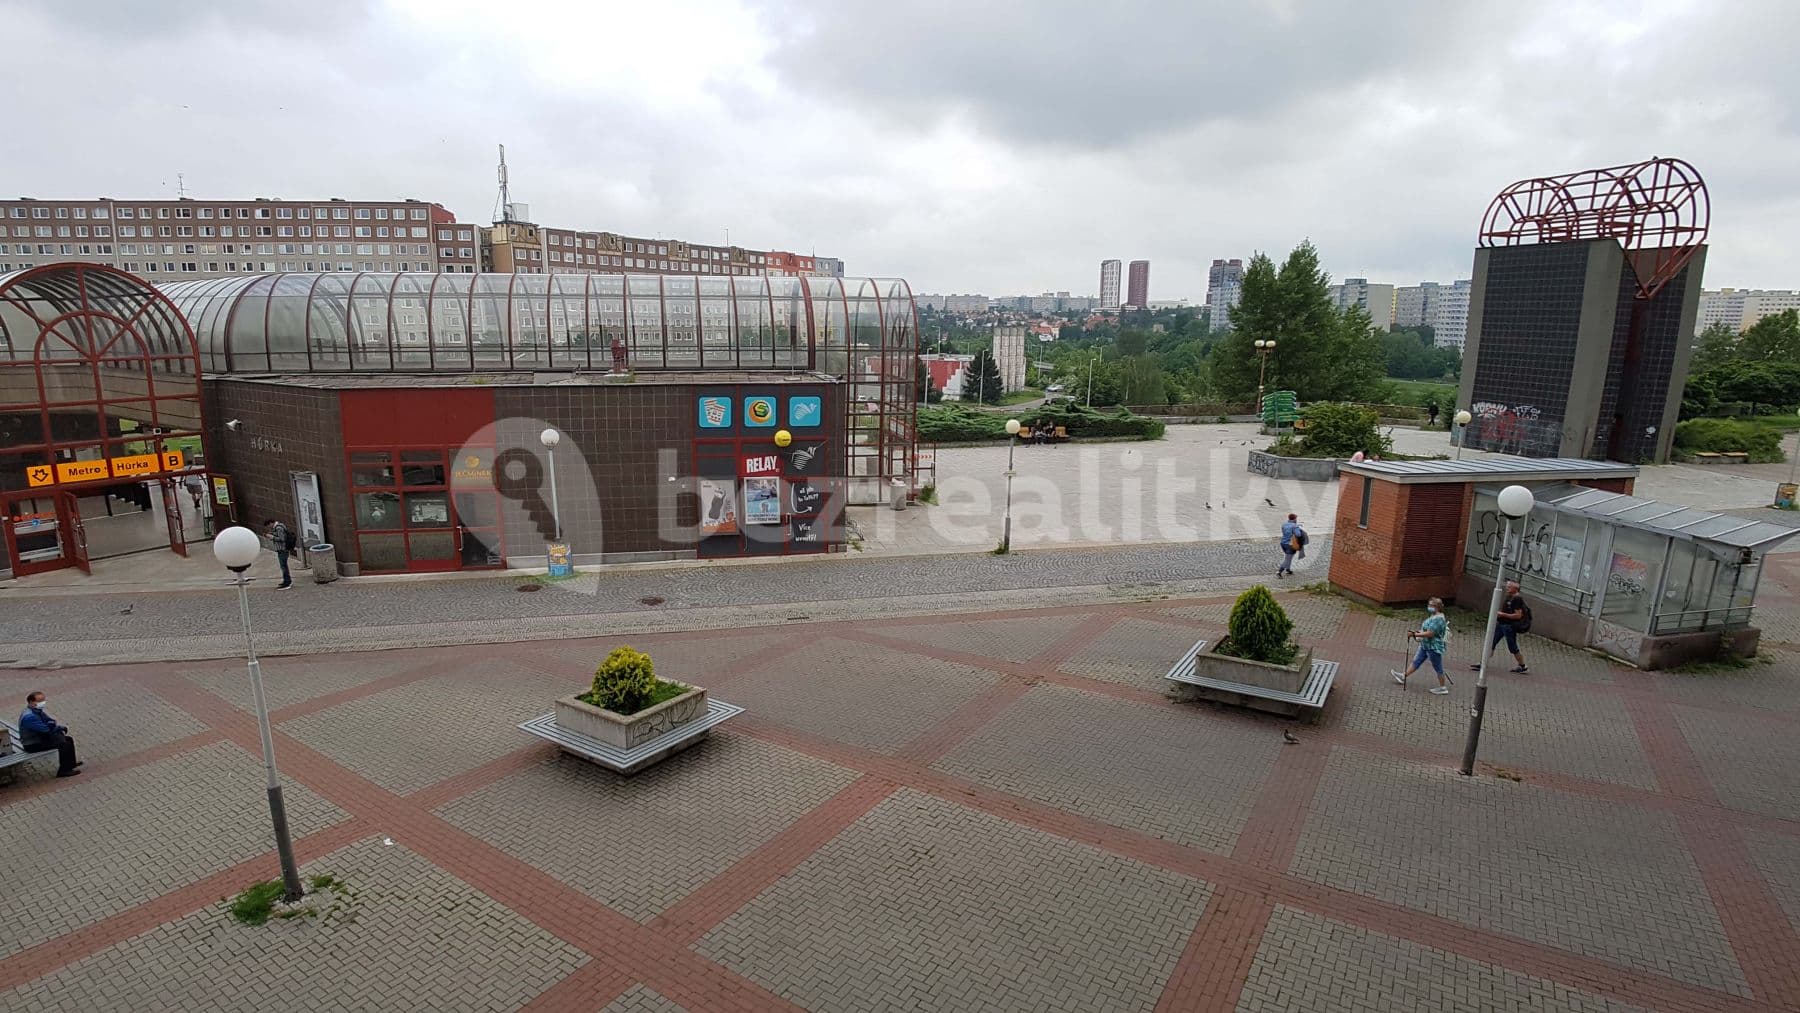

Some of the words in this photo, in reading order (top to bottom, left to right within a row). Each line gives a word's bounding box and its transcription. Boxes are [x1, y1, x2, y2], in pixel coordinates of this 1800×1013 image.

[68, 466, 101, 476] Metro
[168, 455, 179, 466] B
[746, 456, 777, 473] RELAY
